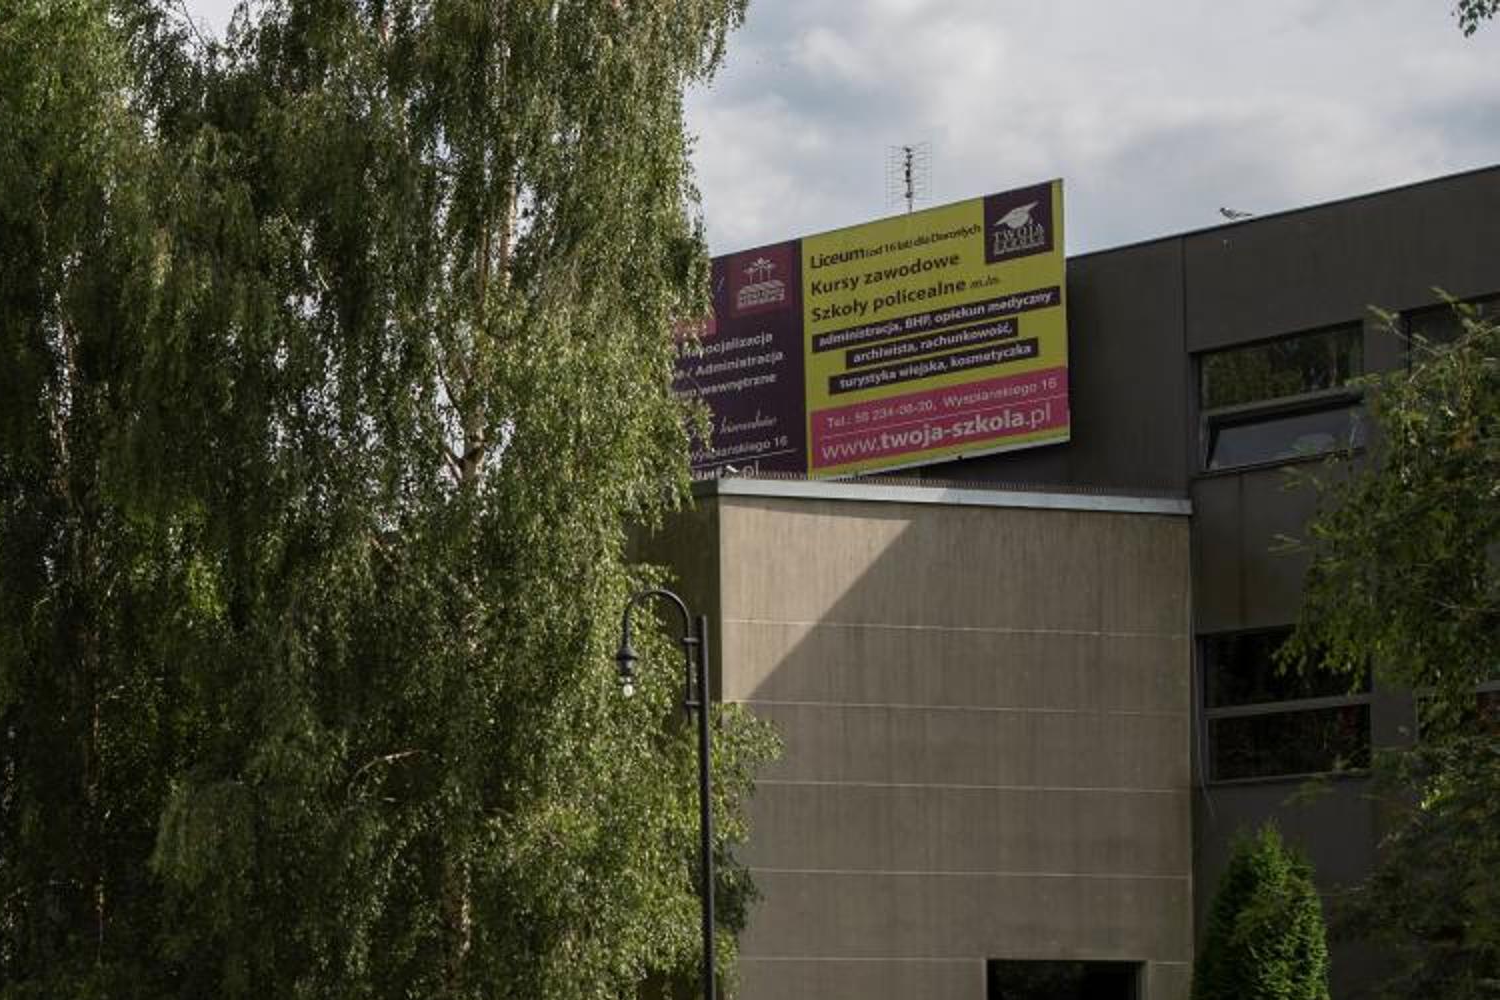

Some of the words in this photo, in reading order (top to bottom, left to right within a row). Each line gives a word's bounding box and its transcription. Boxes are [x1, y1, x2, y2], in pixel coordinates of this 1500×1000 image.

[810, 247, 865, 269] Liceum
[811, 274, 859, 297] Kursy
[864, 254, 960, 284] zawodowe
[812, 296, 868, 322] Szkoły
[873, 276, 967, 311] policealne
[819, 322, 903, 347] administracja,
[935, 305, 985, 325] opiekun
[987, 292, 1052, 314] medyczny
[695, 351, 783, 375] Administracja
[839, 369, 897, 390] turystyka
[899, 360, 948, 381] wiejska,
[950, 343, 1032, 368] kosmetyczka
